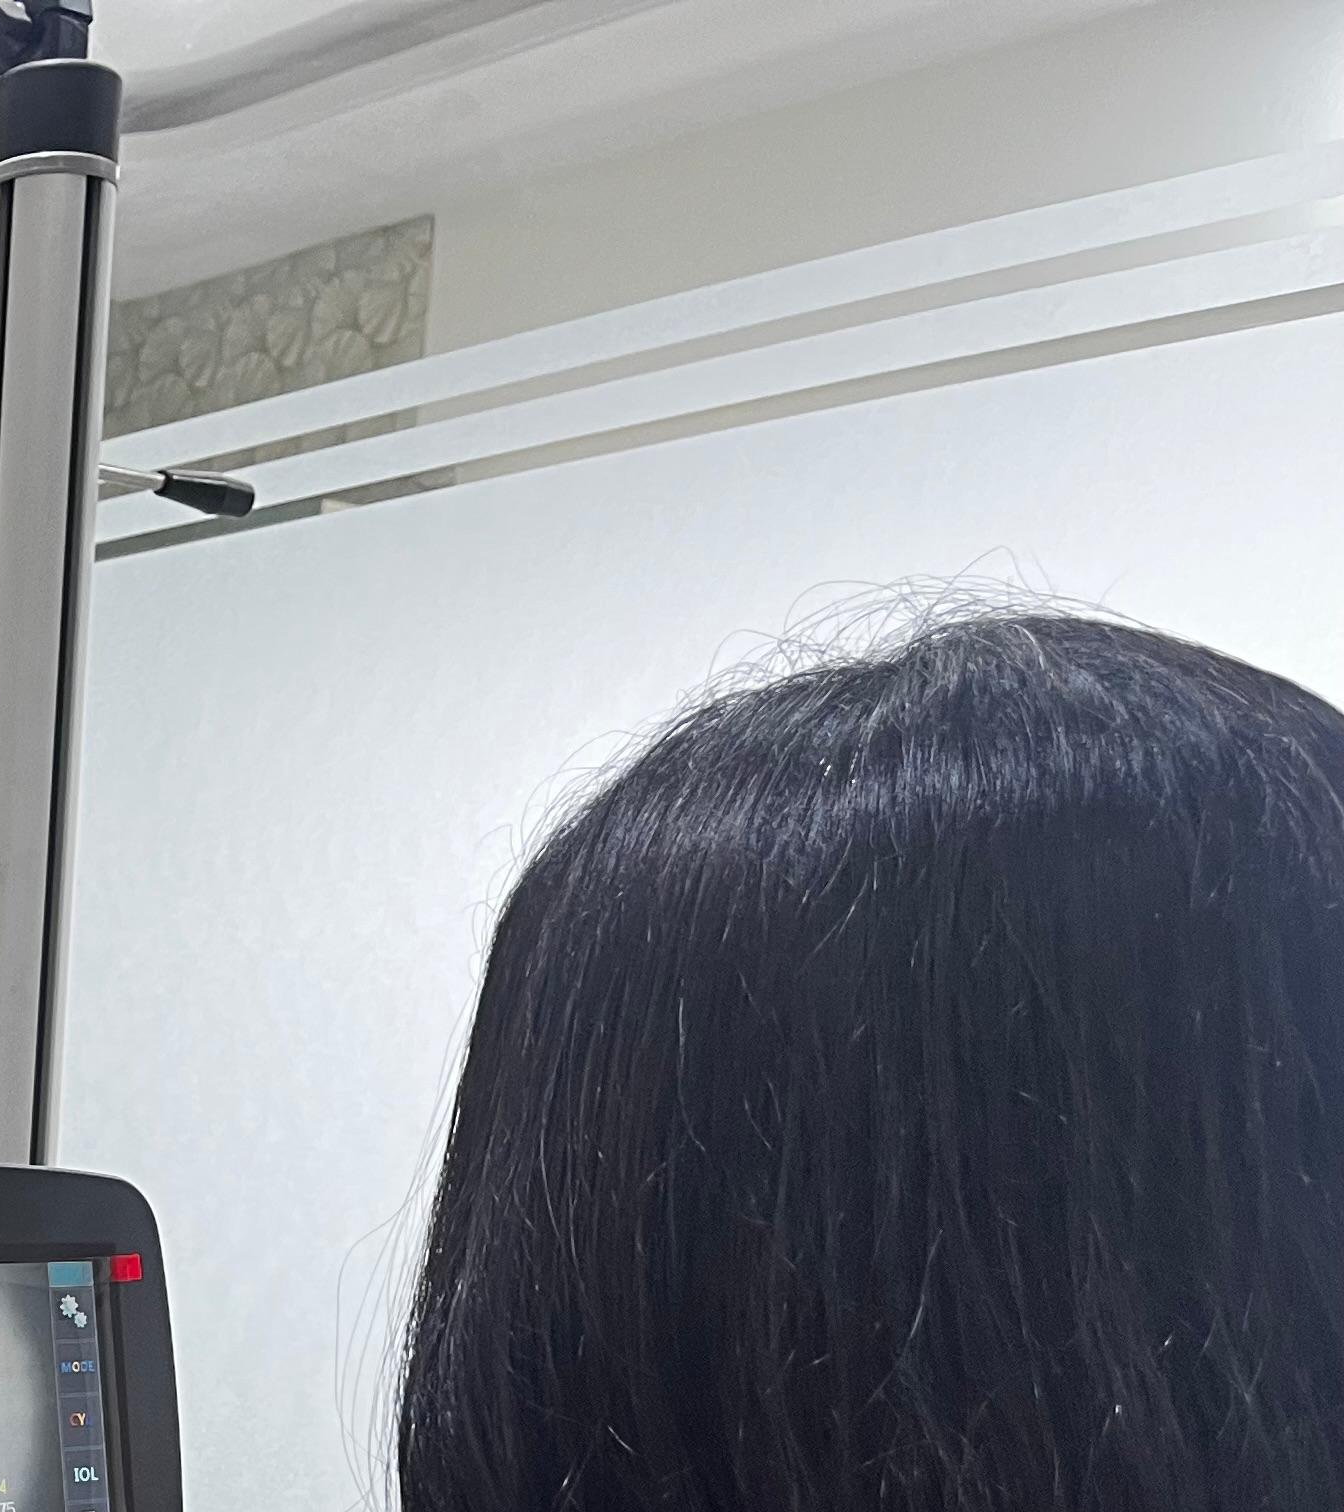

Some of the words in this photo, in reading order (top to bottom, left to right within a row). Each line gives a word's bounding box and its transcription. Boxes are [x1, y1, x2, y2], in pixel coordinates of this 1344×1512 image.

[60, 1360, 95, 1373] MODE
[73, 1466, 100, 1483] IOL
[0, 1479, 8, 1495] 4
